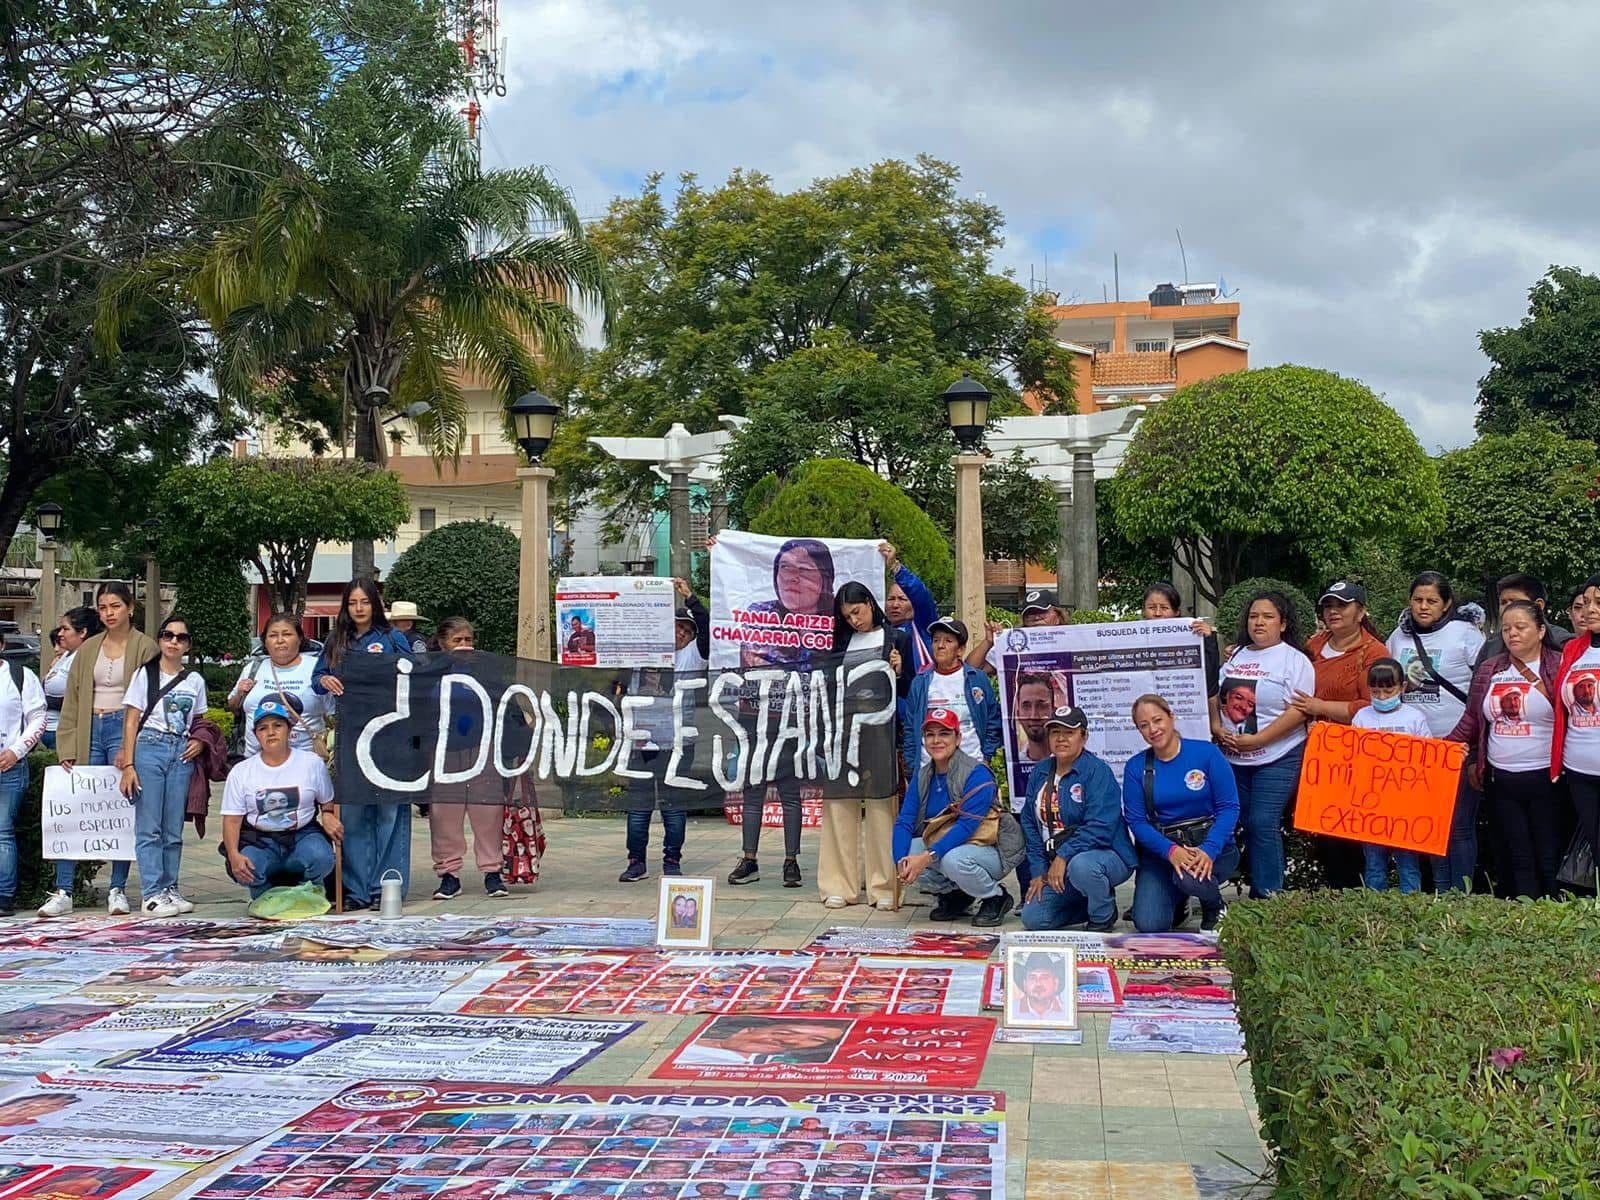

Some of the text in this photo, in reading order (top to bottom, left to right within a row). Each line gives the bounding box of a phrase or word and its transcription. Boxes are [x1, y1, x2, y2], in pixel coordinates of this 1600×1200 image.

[732, 609, 779, 626] TANIA
[712, 627, 800, 647] CHAVARRIA
[1139, 627, 1151, 635] DE
[356, 657, 896, 792] ¿DONDE ESTAN?
[1305, 757, 1321, 786] a
[1328, 762, 1353, 787] mi
[434, 1092, 594, 1106] ZONA
[606, 1094, 789, 1108] MEDIA
